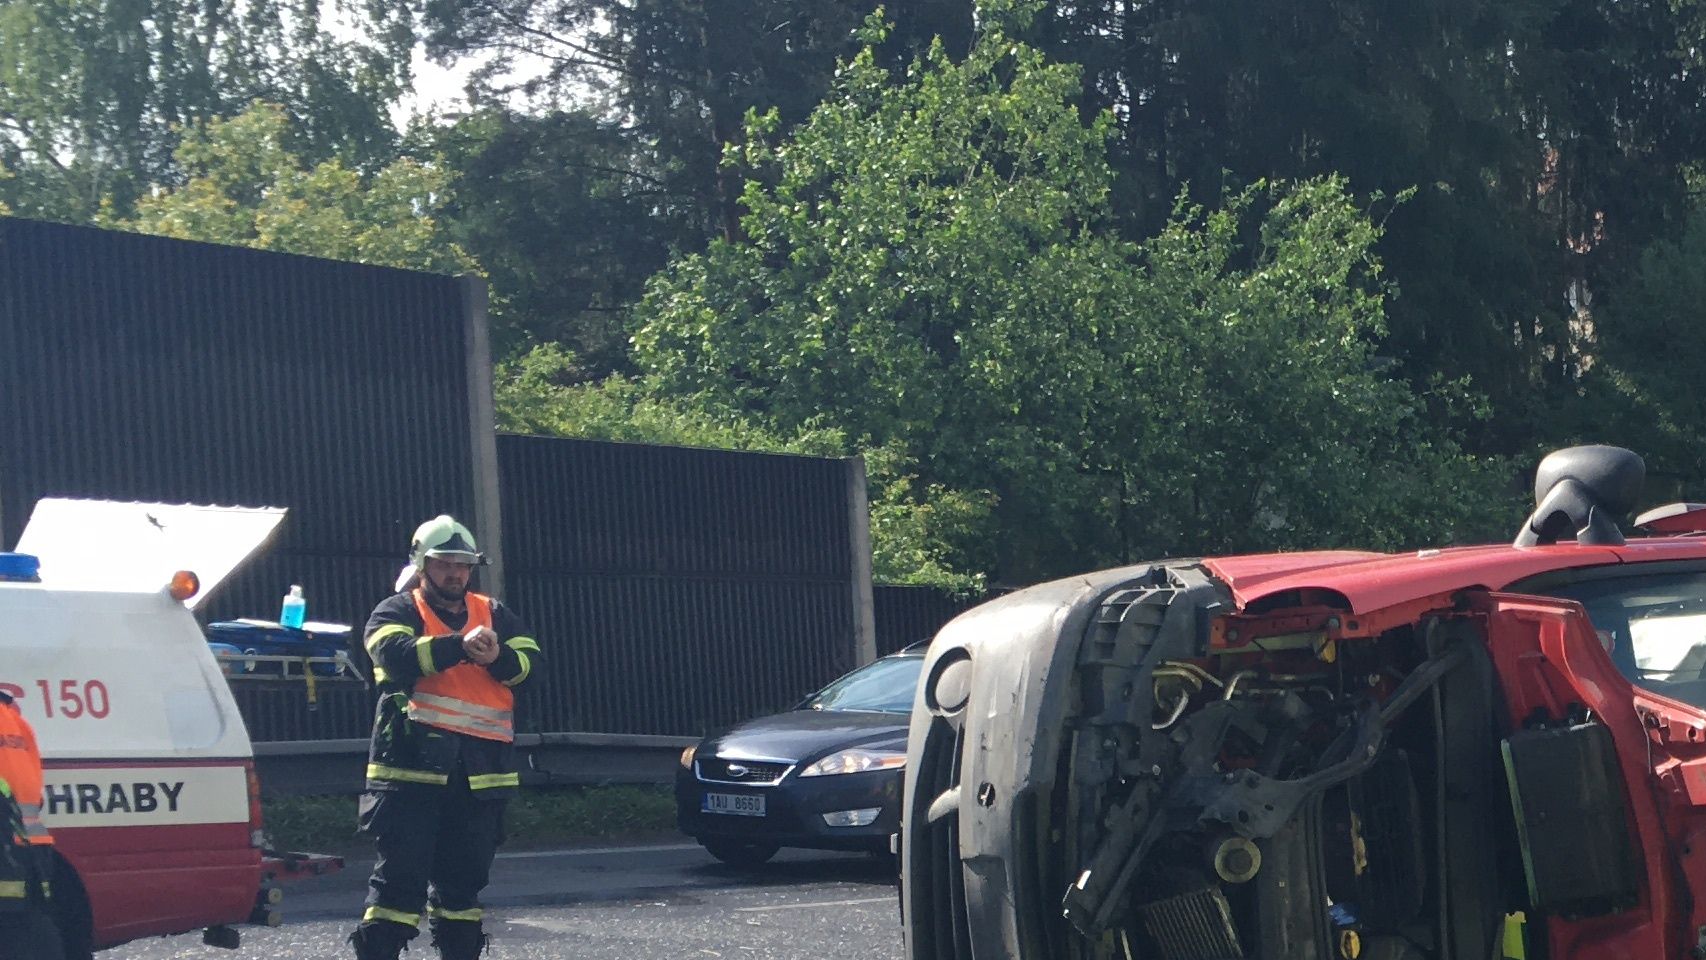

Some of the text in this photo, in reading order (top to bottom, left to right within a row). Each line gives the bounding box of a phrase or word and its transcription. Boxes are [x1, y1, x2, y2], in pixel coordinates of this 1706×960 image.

[36, 679, 110, 719] 150
[40, 782, 184, 815] HRABY
[710, 795, 728, 808] 1AU
